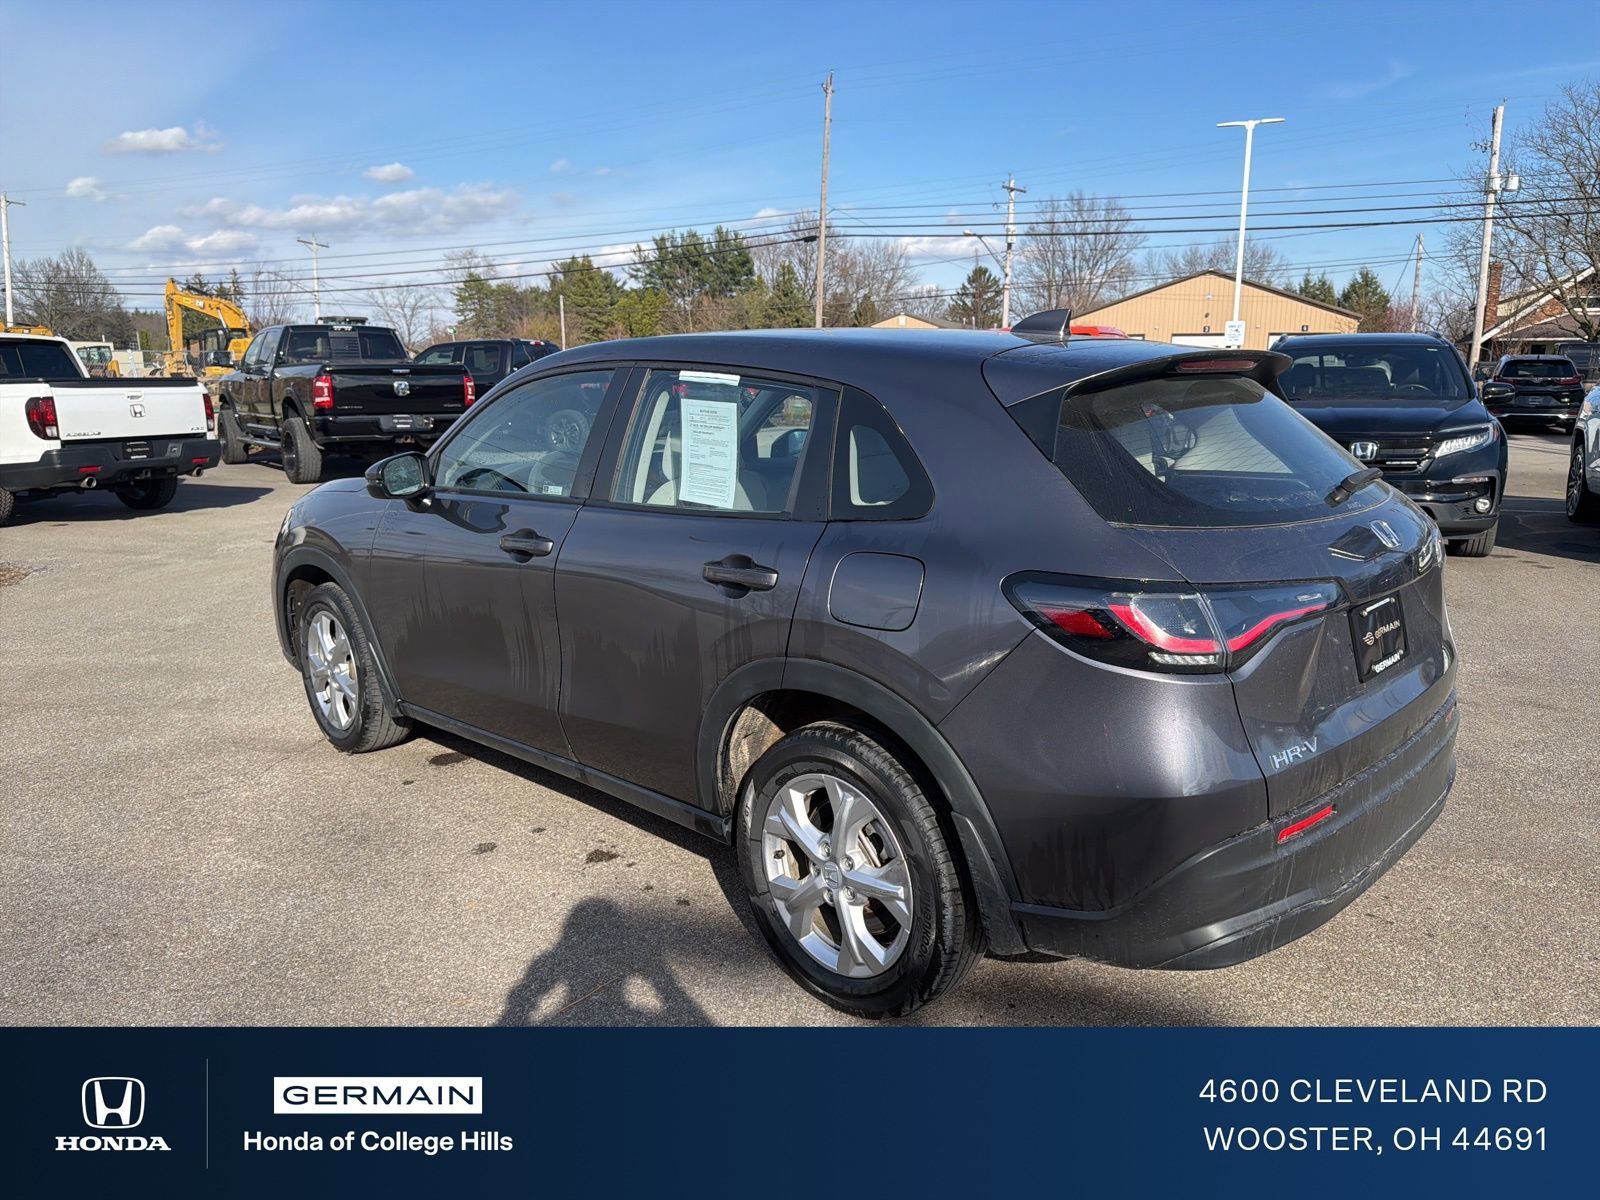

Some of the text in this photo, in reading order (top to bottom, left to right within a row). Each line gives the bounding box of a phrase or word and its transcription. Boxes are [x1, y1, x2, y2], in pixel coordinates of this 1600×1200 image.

[1374, 619, 1401, 639] GERMAIN
[1375, 652, 1401, 673] GERMAIN
[1272, 736, 1318, 769] HR-V
